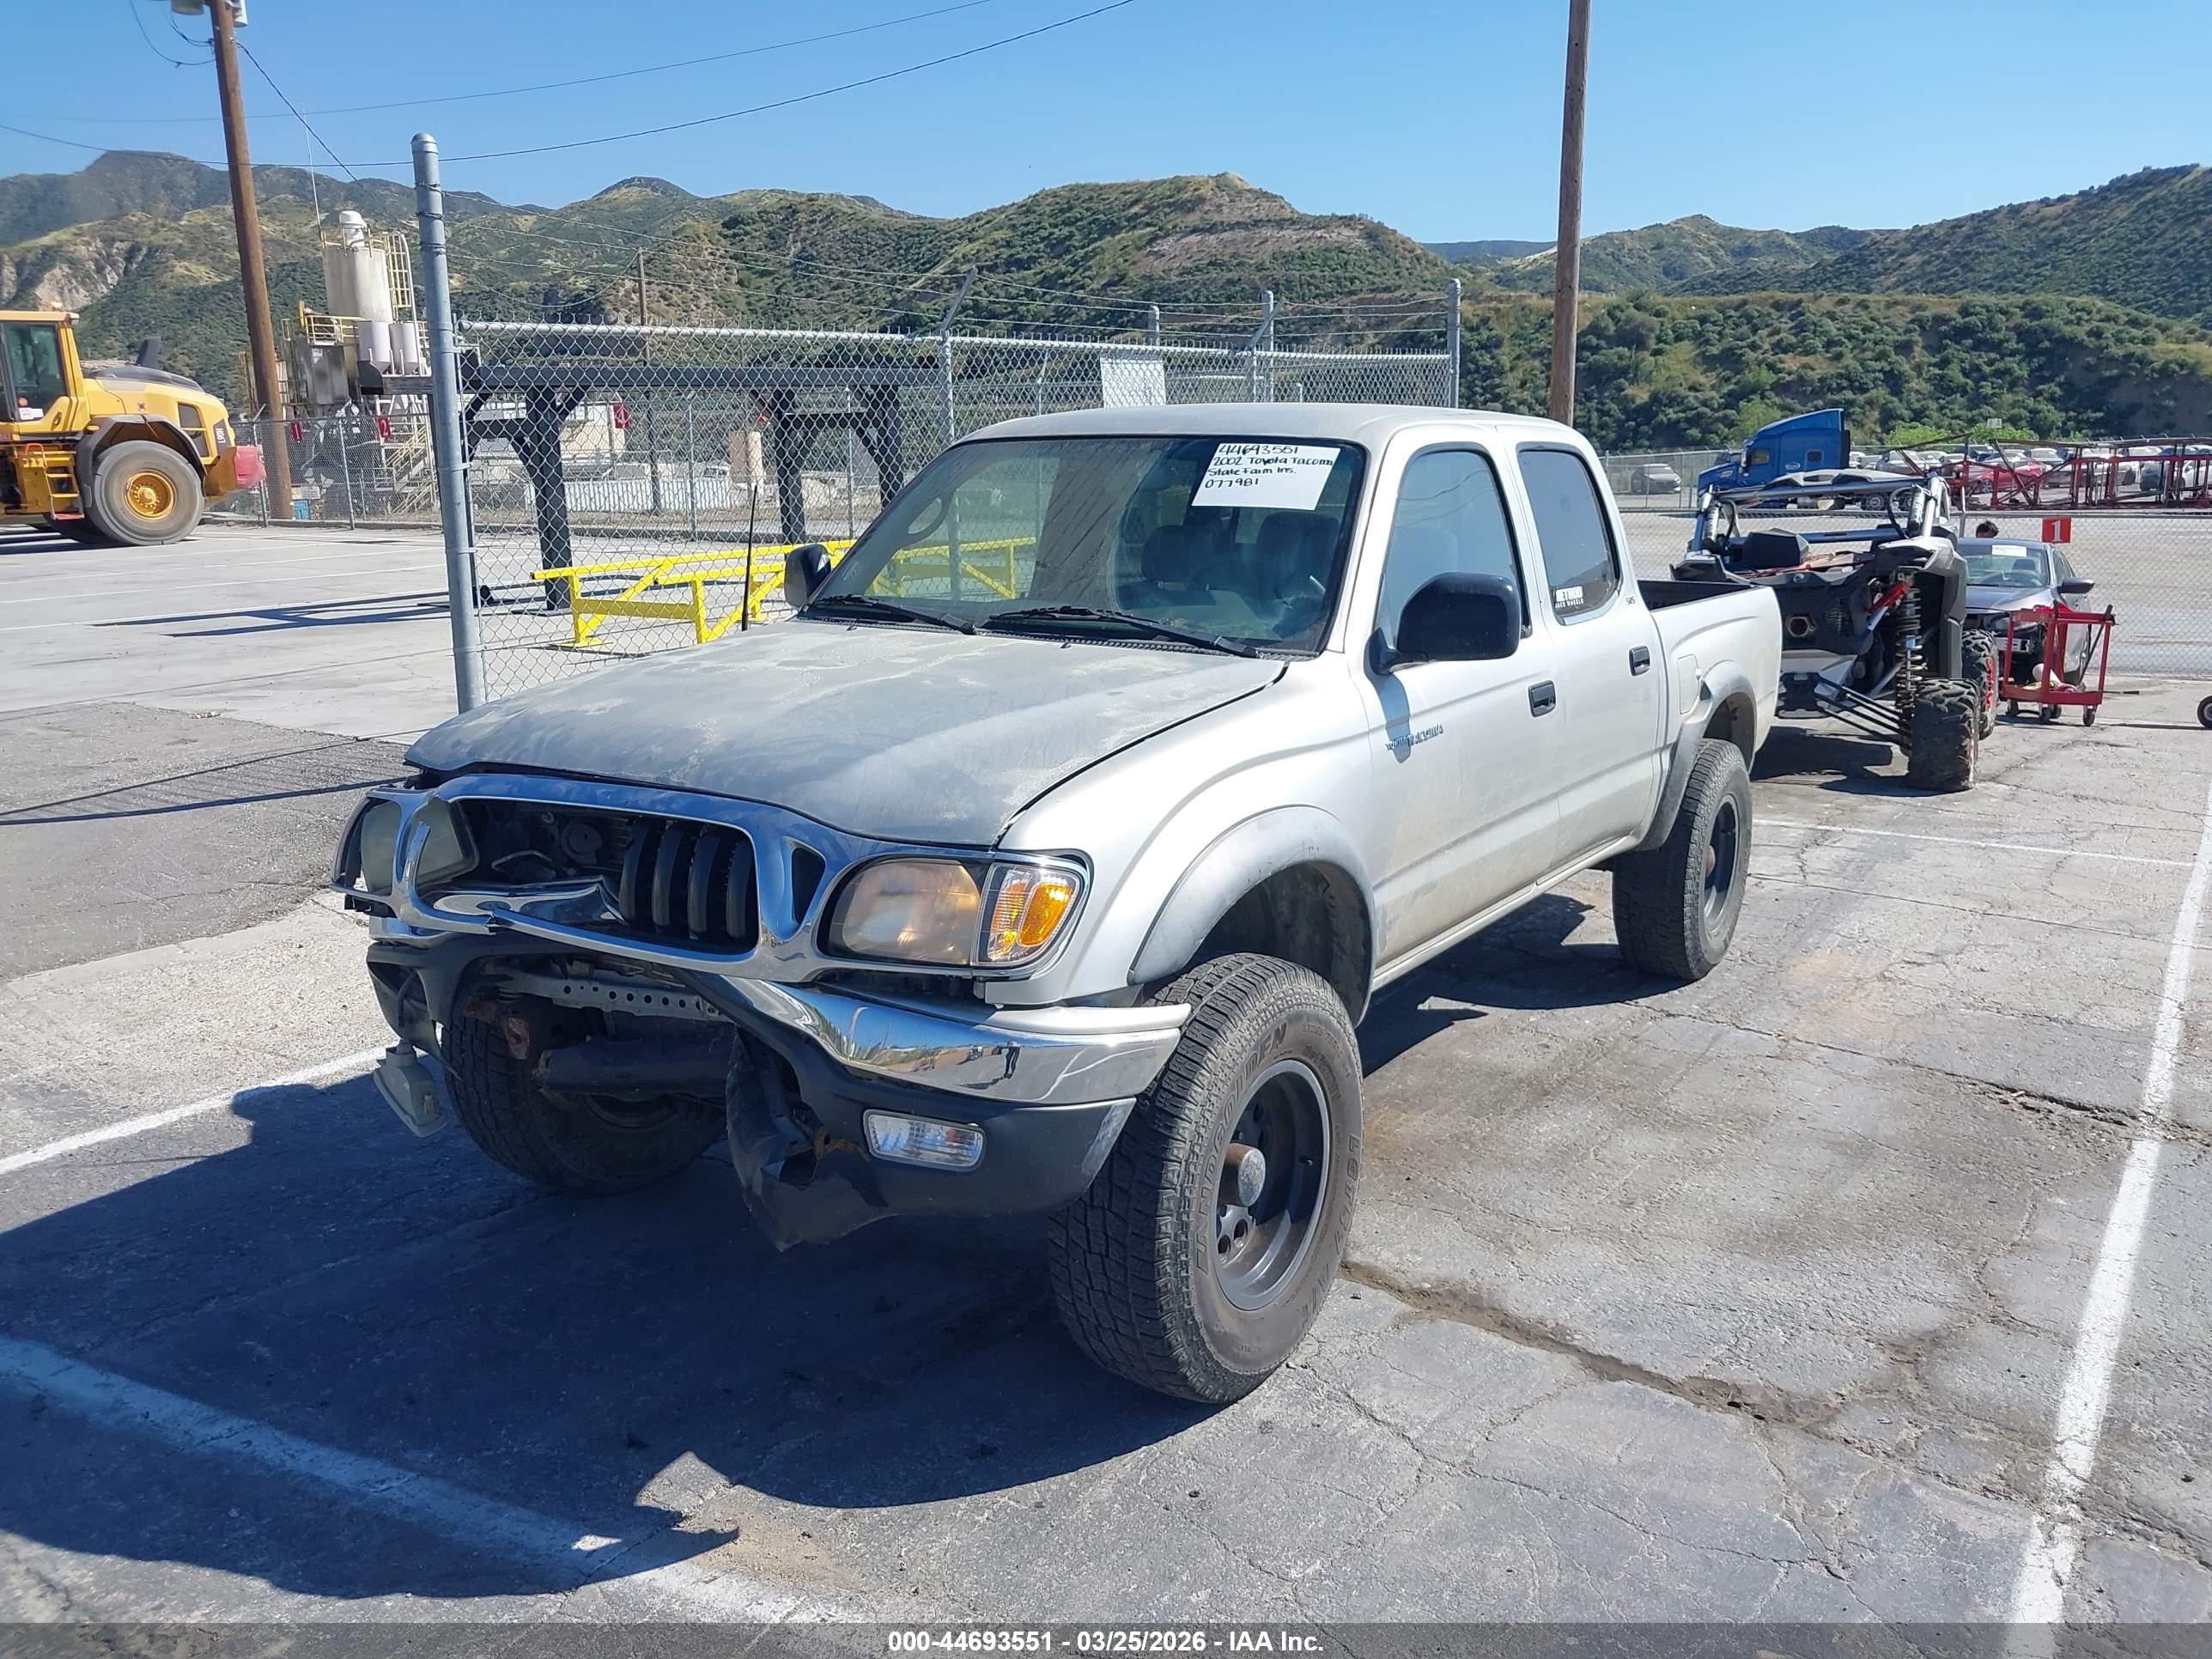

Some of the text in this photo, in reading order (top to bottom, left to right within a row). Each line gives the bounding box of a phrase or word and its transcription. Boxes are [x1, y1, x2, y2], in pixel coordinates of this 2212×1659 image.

[294, 423, 301, 440] 1
[380, 419, 389, 436] 2
[1218, 444, 1298, 456] 44693551
[1212, 456, 1243, 466] 2002
[1248, 457, 1287, 466] Toyota
[1207, 467, 1242, 477] State
[1243, 466, 1273, 475] Farm
[1205, 477, 1260, 489] 077981
[2051, 520, 2063, 543] 1
